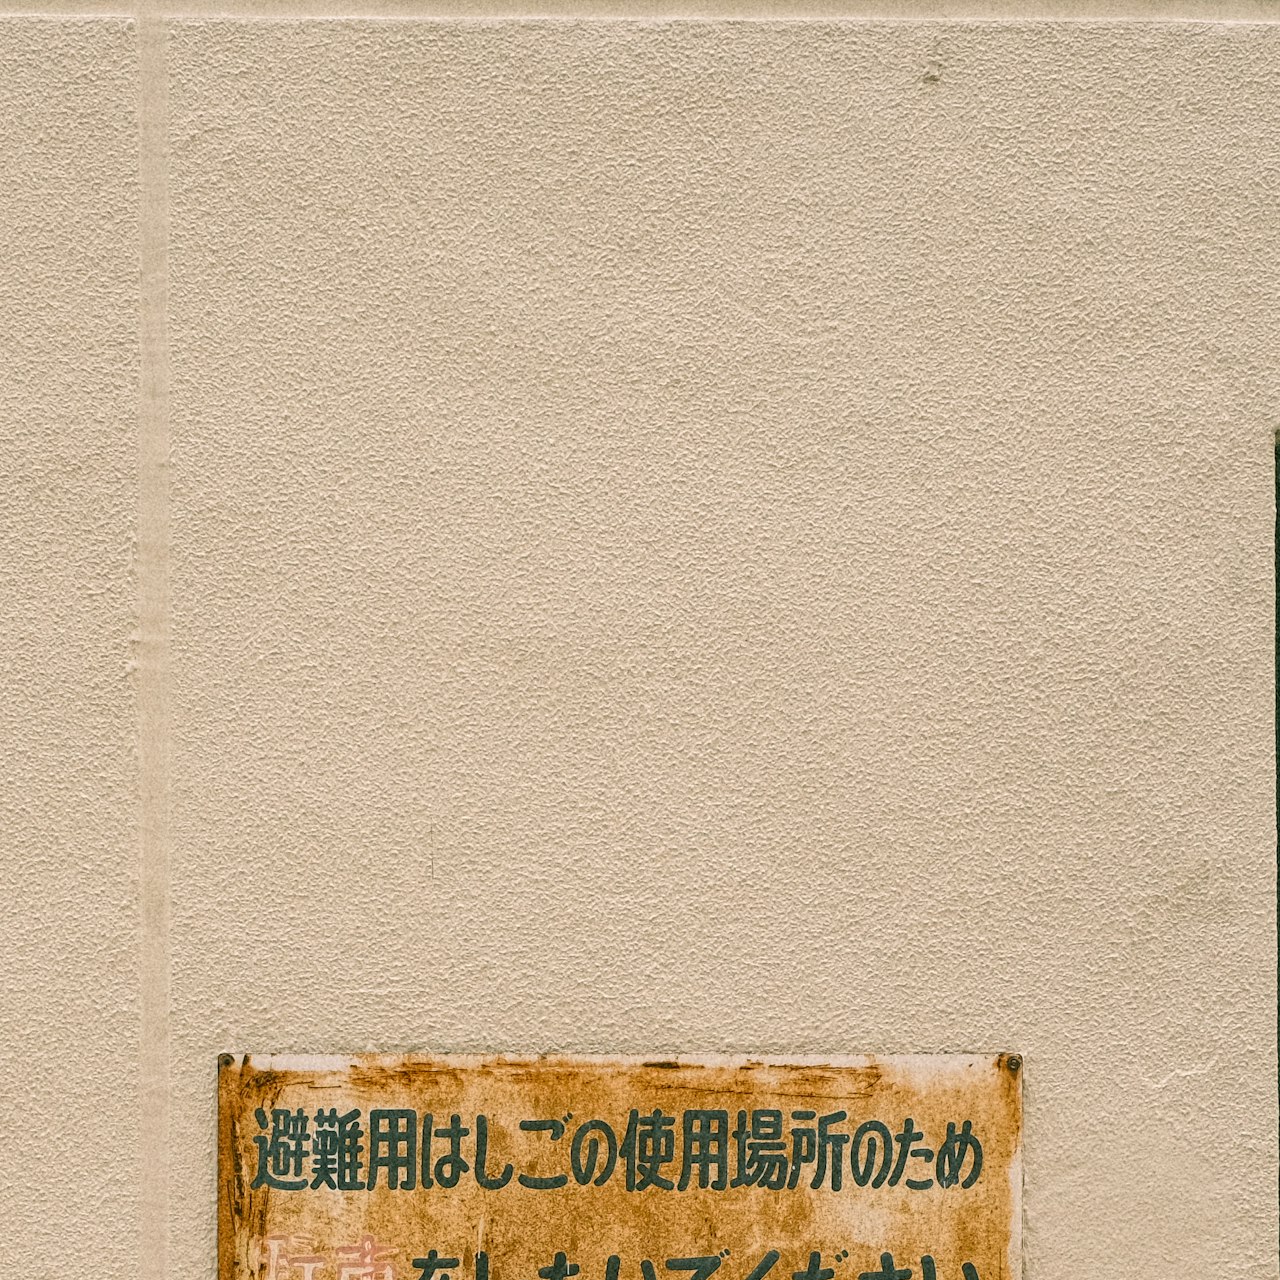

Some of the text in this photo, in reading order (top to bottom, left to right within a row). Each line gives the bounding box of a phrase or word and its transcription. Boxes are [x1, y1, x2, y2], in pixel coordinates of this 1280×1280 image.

[250, 1107, 984, 1192] 避難用はしごの使用場所のため
